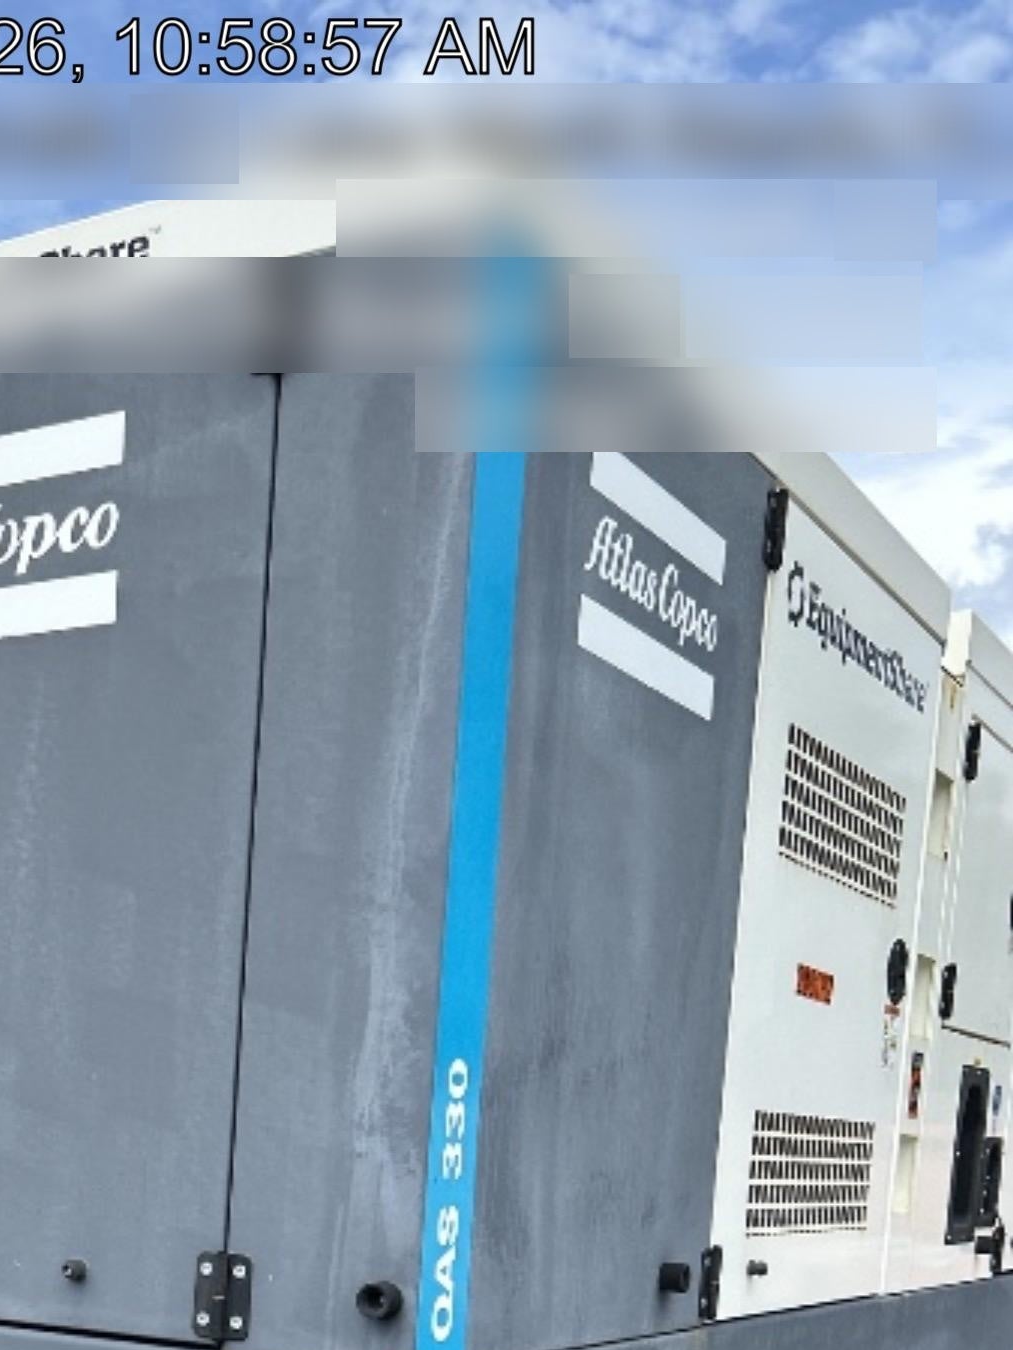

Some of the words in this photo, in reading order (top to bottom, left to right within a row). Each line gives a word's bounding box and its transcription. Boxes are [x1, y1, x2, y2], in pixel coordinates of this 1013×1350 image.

[583, 515, 658, 613] Atlas
[658, 563, 718, 652] Copco
[441, 1057, 469, 1180] 330
